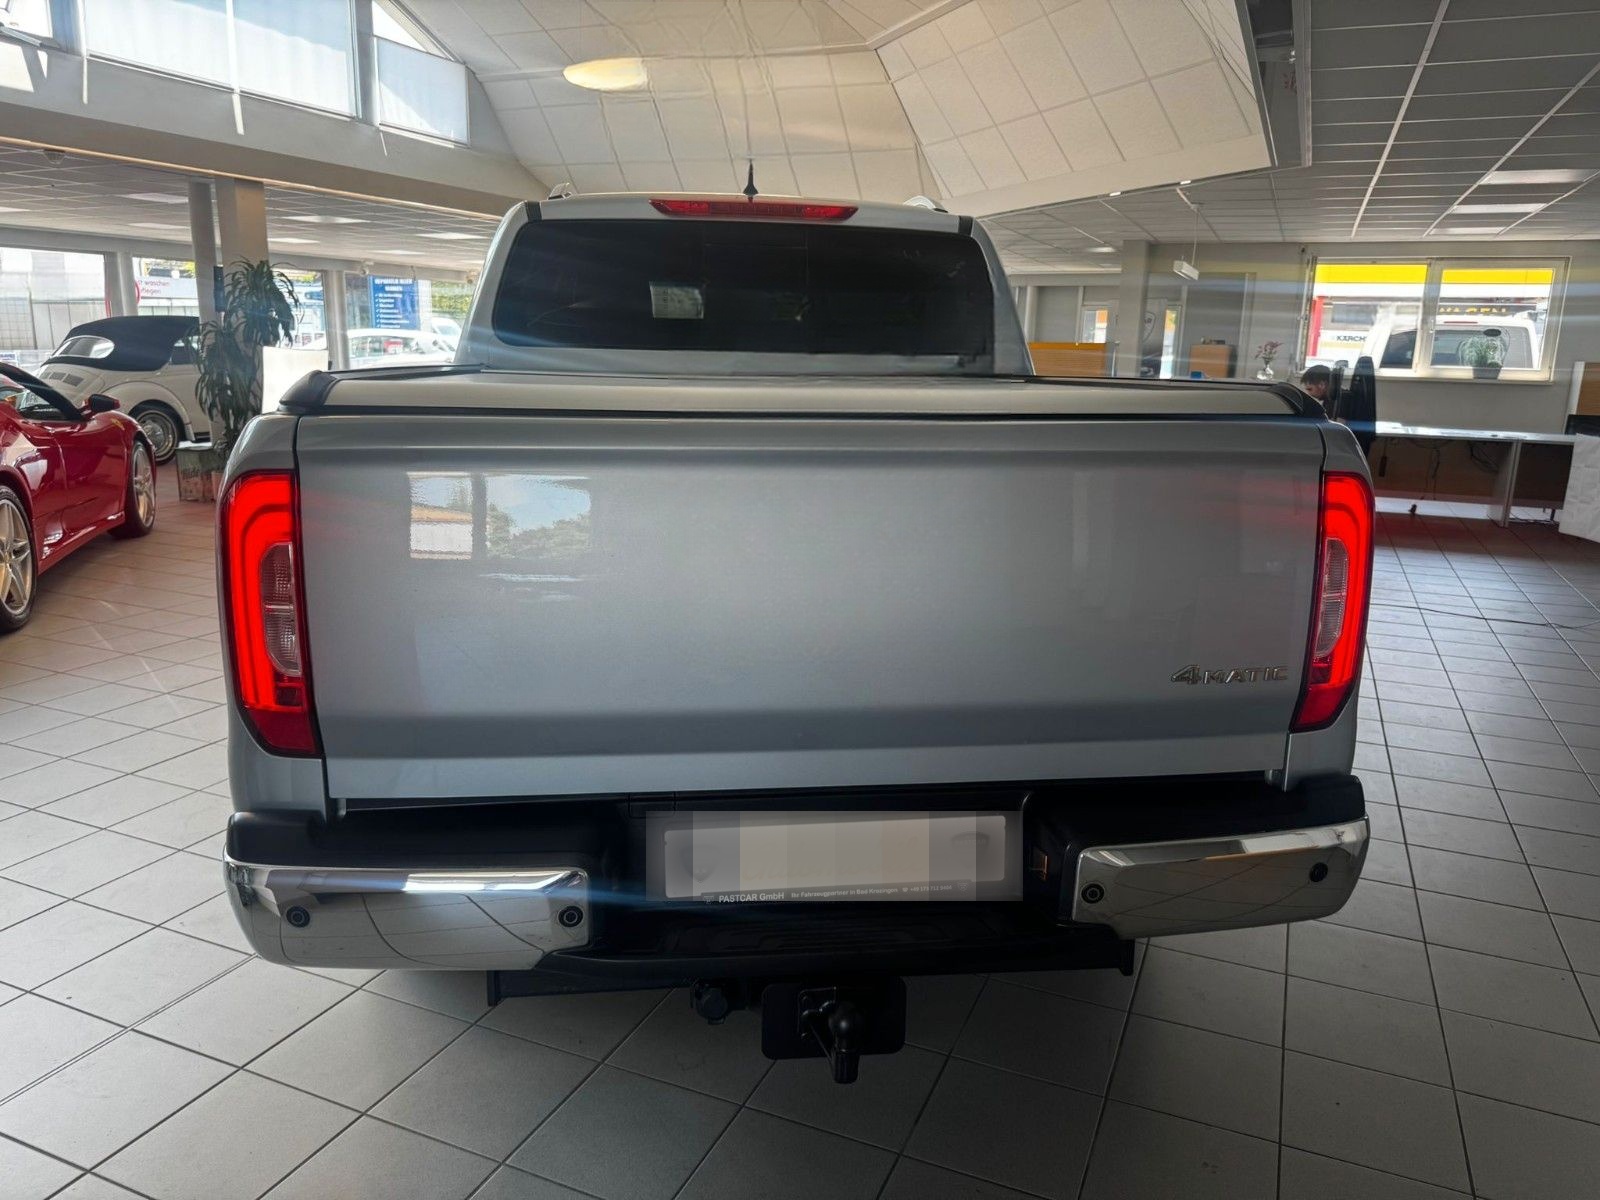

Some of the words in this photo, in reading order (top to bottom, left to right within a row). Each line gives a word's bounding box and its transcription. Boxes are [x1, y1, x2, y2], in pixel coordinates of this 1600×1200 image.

[1170, 664, 1288, 684] 4MATIC
[719, 894, 758, 903] PASTCAR
[760, 892, 785, 901] GmbH
[801, 890, 849, 898] Fahrzeugpartner
